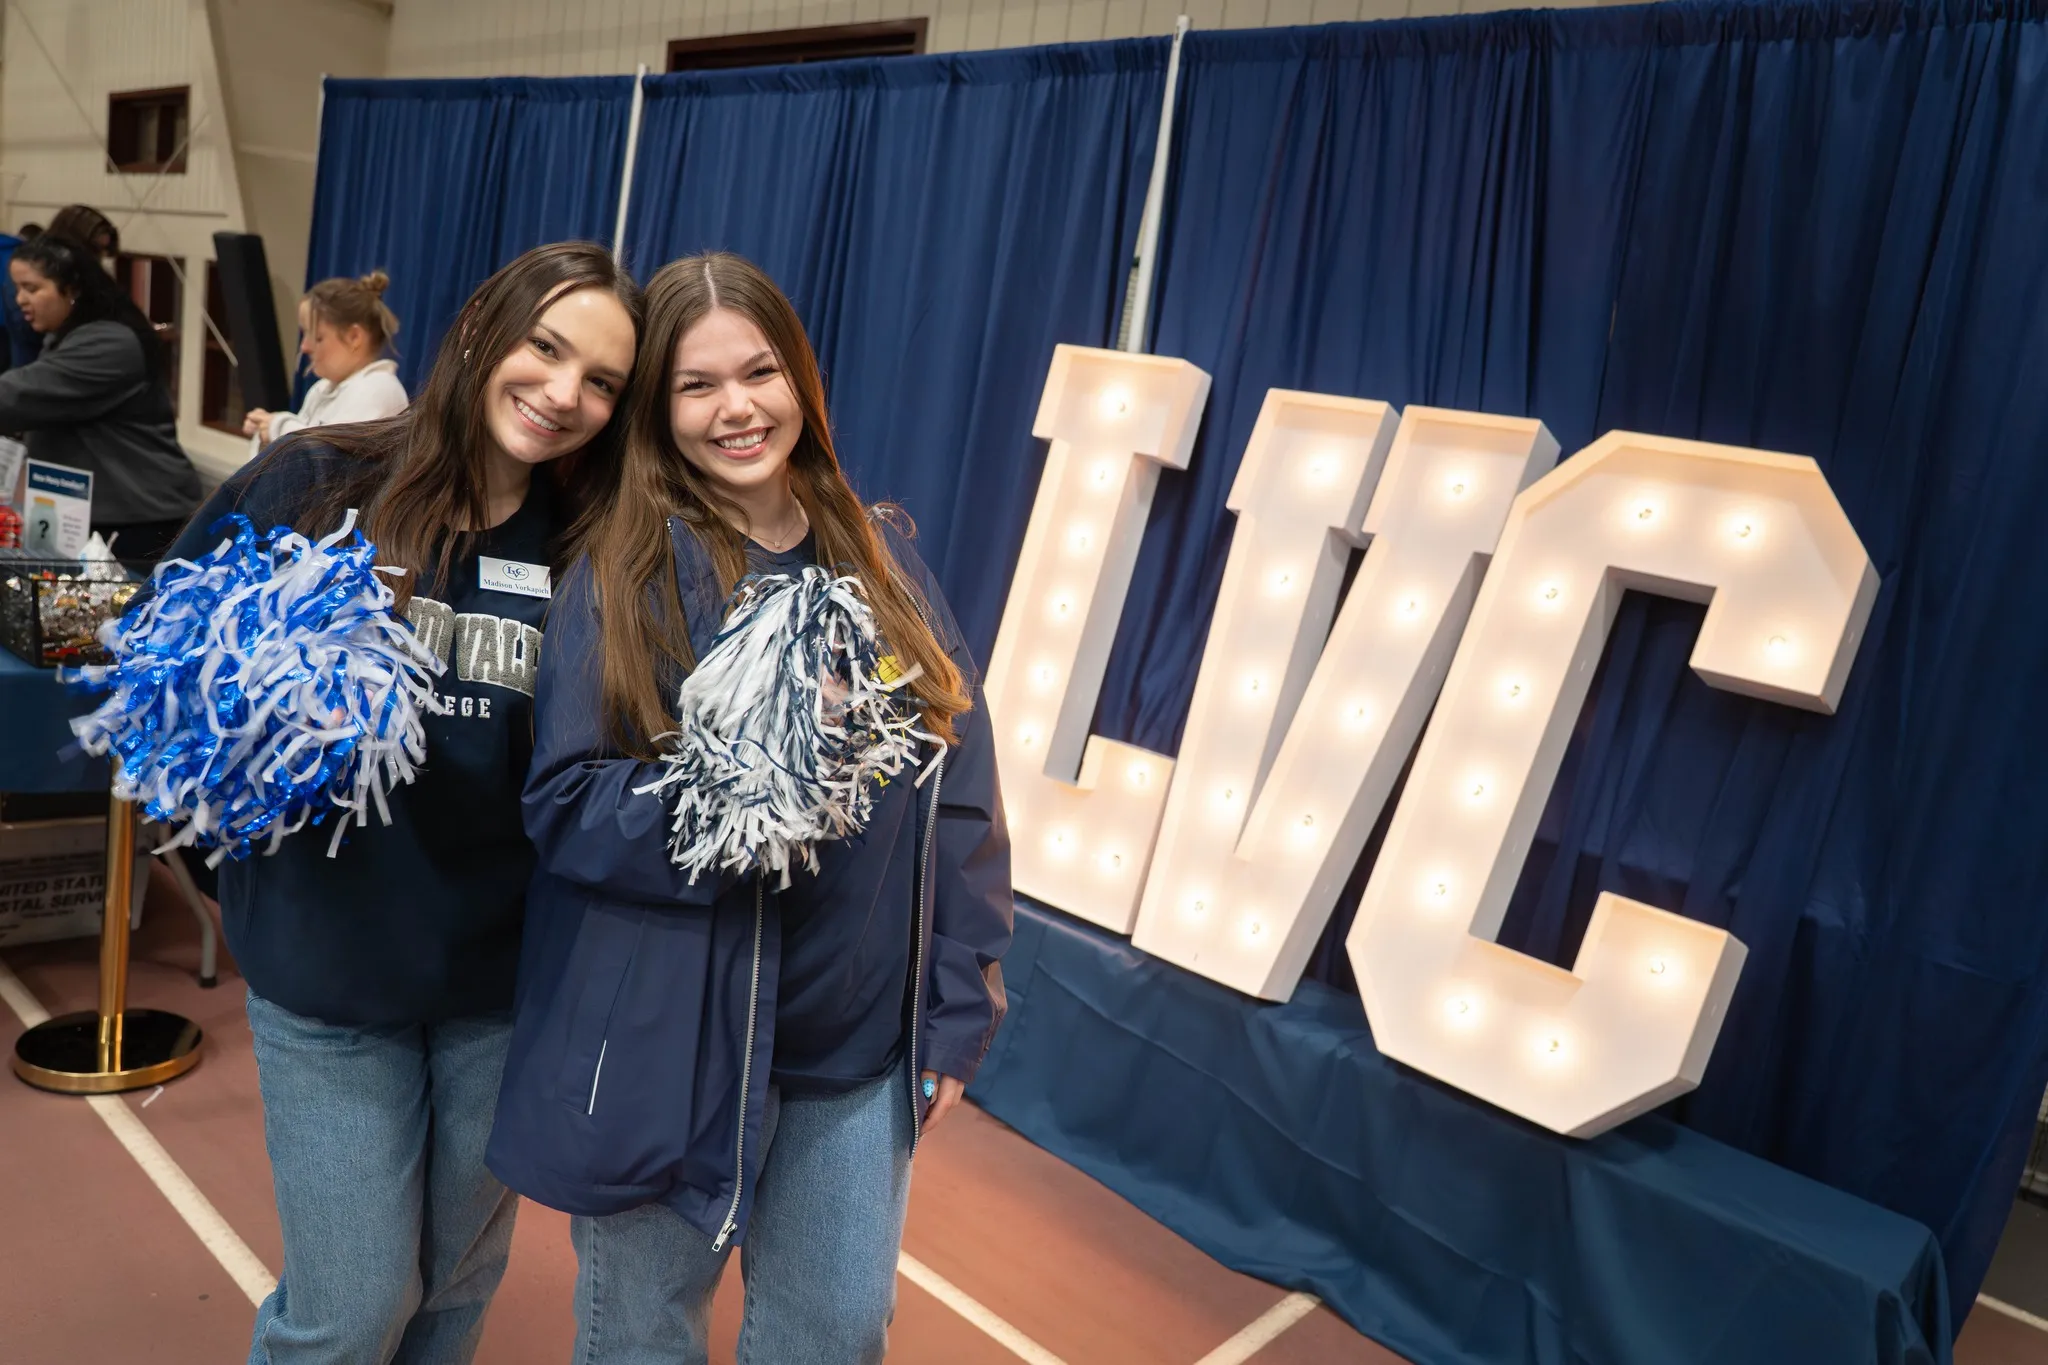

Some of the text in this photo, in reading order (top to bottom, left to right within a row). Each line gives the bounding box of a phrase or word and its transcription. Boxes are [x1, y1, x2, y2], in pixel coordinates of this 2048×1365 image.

[484, 579, 513, 589] Madison
[455, 613, 544, 698] VALL
[983, 343, 1881, 1139] LVC
